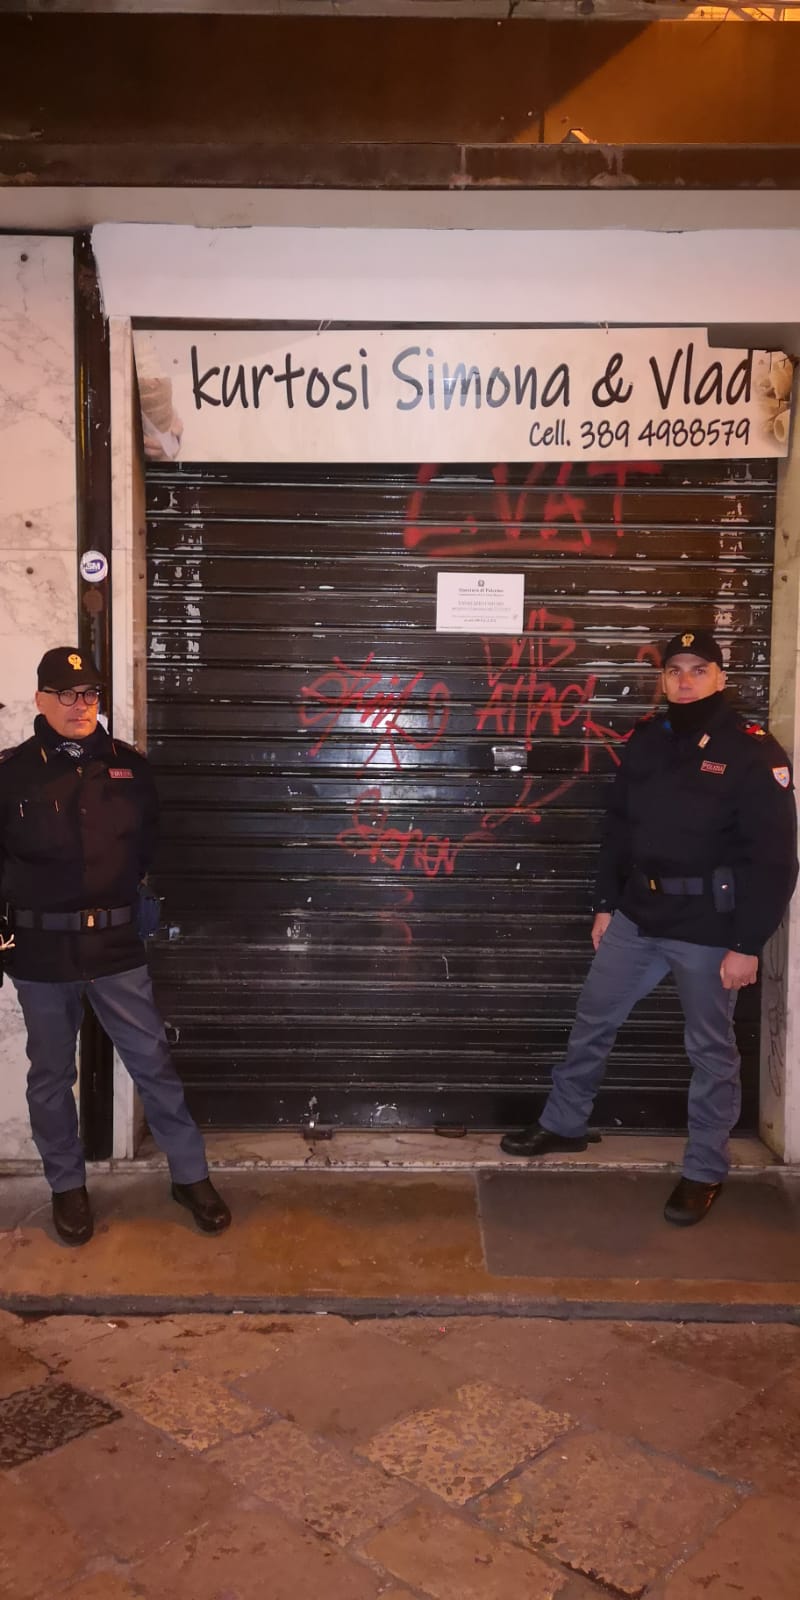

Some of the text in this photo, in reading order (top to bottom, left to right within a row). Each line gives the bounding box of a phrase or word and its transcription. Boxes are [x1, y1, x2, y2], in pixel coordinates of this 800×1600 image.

[190, 342, 754, 411] kurtosi Simona & Vlad
[529, 417, 750, 450] Cell. 389 4988579
